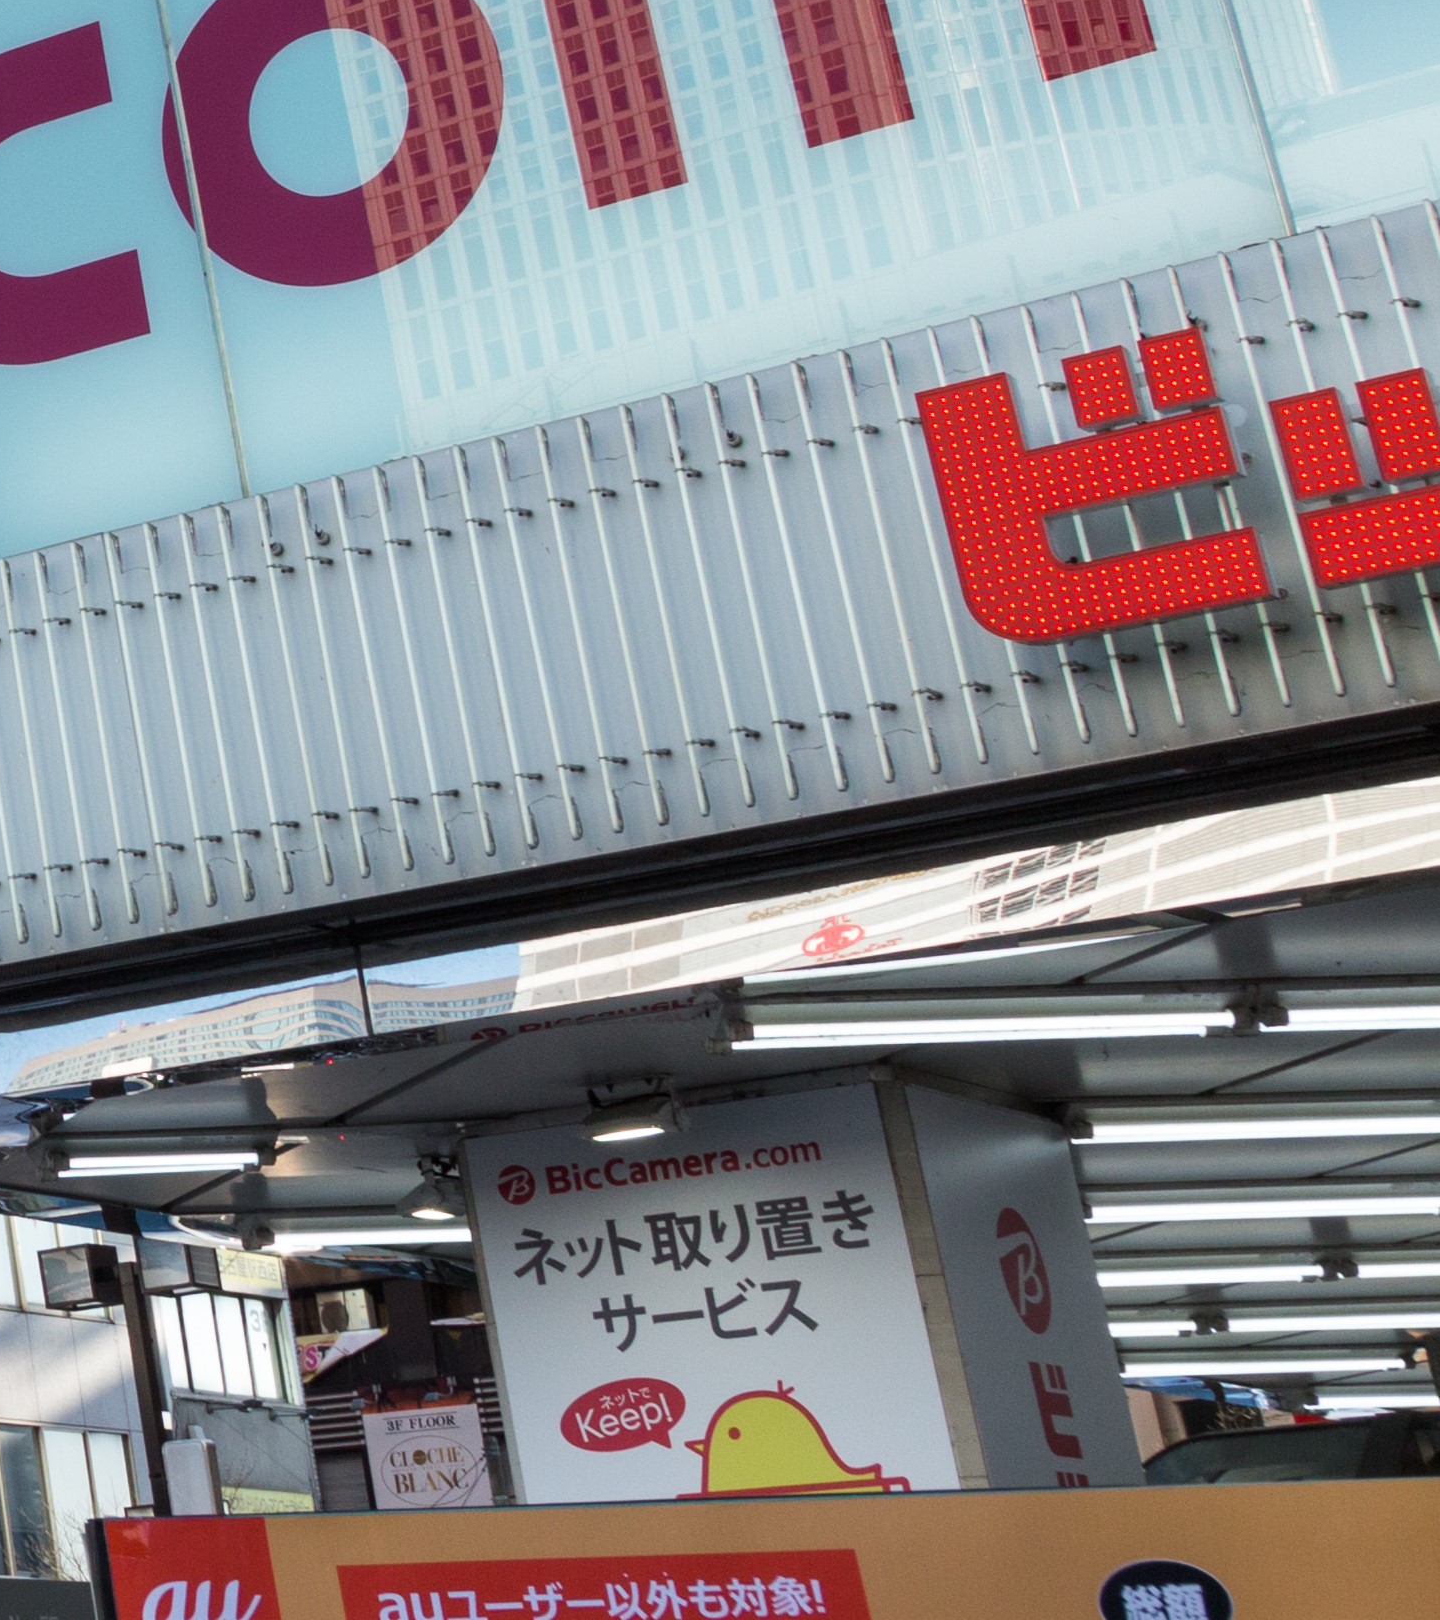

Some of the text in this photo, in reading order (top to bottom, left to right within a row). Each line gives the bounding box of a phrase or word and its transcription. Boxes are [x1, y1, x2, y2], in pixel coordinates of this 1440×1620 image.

[545, 1141, 822, 1196] BicCamera.com
[514, 1189, 875, 1286] ネット取り置き
[592, 1277, 819, 1353] サービス
[575, 1392, 674, 1444] Keep!
[599, 1386, 651, 1411] ネットで
[409, 1415, 456, 1429] FLOOR
[389, 1446, 465, 1469] CLOCHE
[393, 1467, 469, 1494] BLANC
